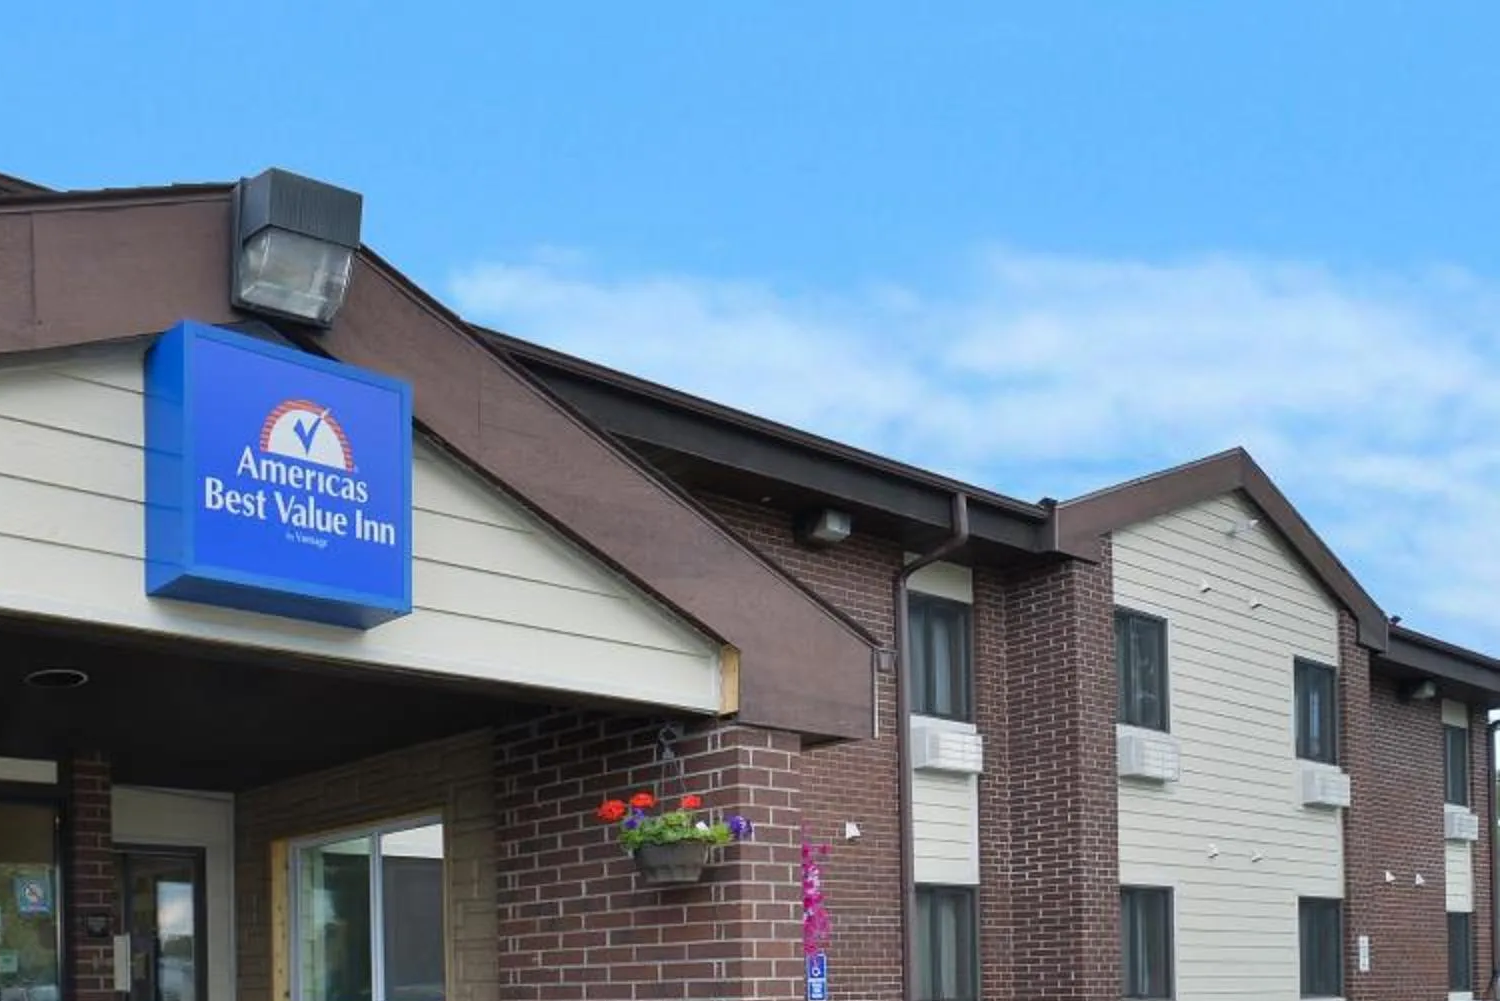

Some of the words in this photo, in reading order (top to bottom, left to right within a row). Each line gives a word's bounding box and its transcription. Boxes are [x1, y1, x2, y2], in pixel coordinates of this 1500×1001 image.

[237, 446, 368, 502] Americas
[204, 476, 267, 520] Best
[273, 491, 348, 536] Value
[355, 509, 396, 545] Inn
